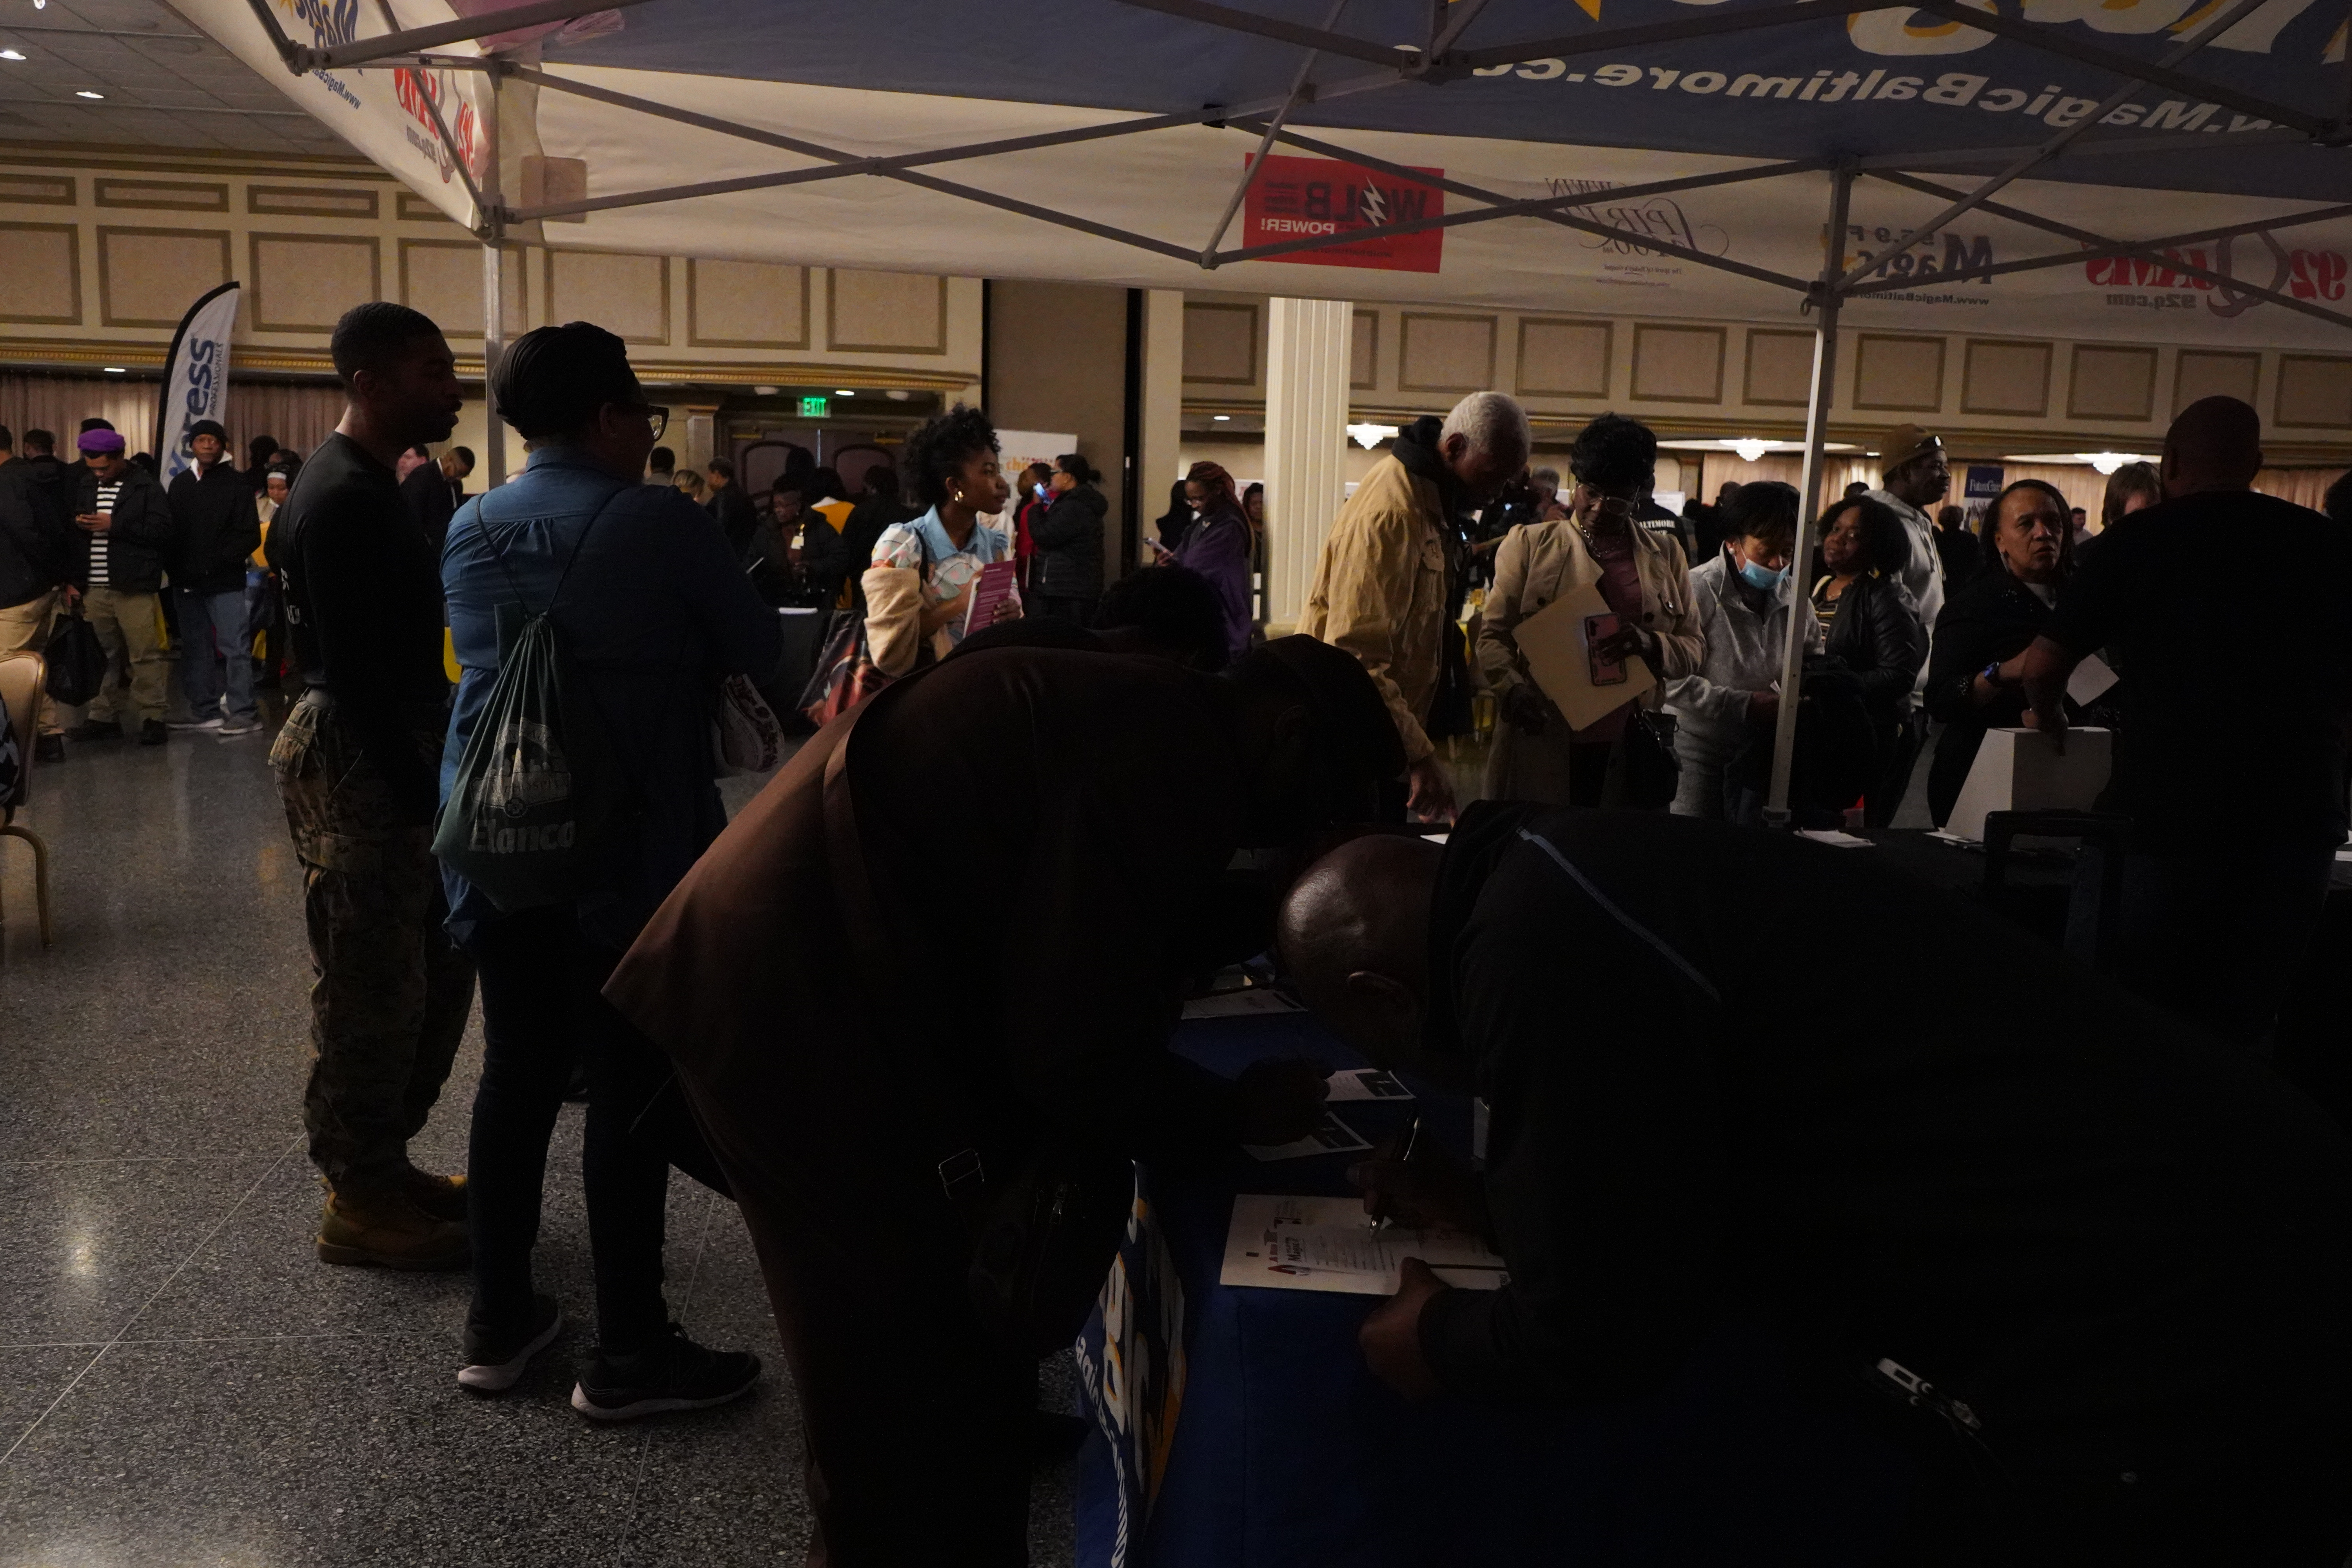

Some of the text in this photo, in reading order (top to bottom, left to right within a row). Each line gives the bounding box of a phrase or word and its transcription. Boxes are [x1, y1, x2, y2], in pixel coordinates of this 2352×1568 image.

[803, 397, 827, 417] EXIT
[1639, 519, 1676, 528] ALTIMORE
[468, 818, 577, 855] Elanco
